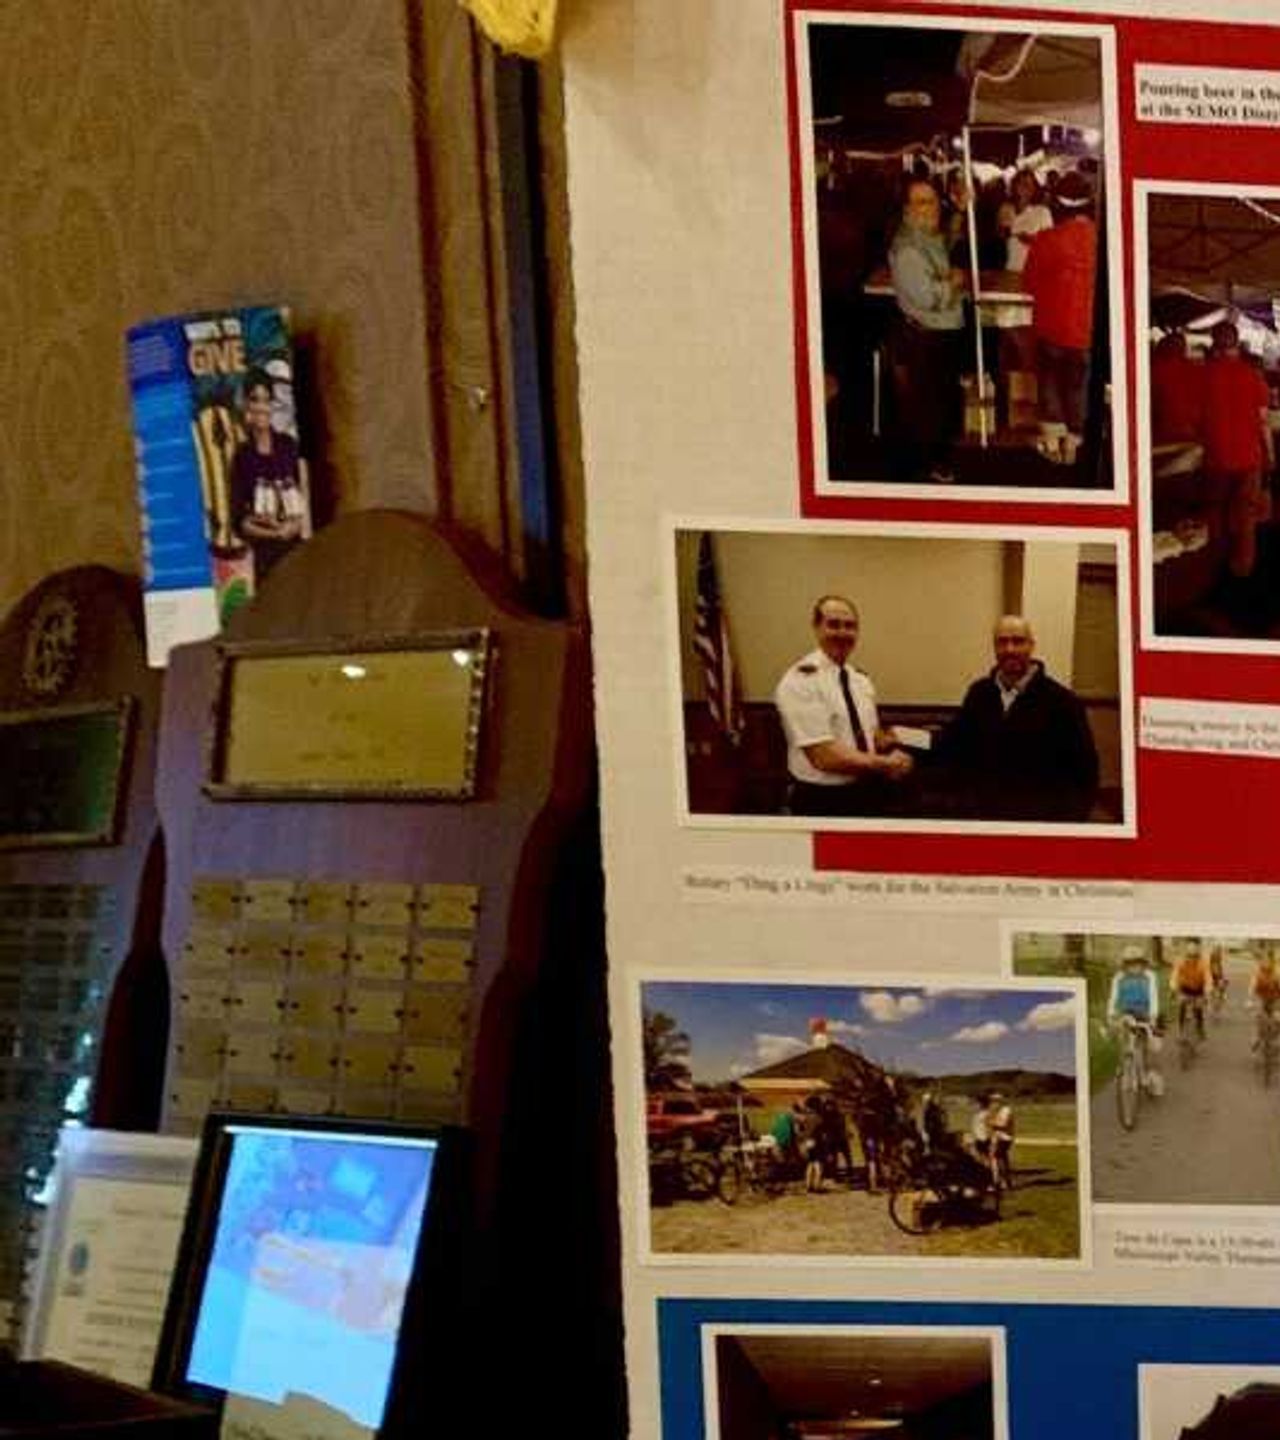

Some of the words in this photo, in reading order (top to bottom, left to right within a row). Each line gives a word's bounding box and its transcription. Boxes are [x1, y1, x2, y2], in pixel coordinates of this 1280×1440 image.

[1203, 82, 1235, 98] beer
[1159, 102, 1181, 117] the
[189, 337, 248, 376] GIVE
